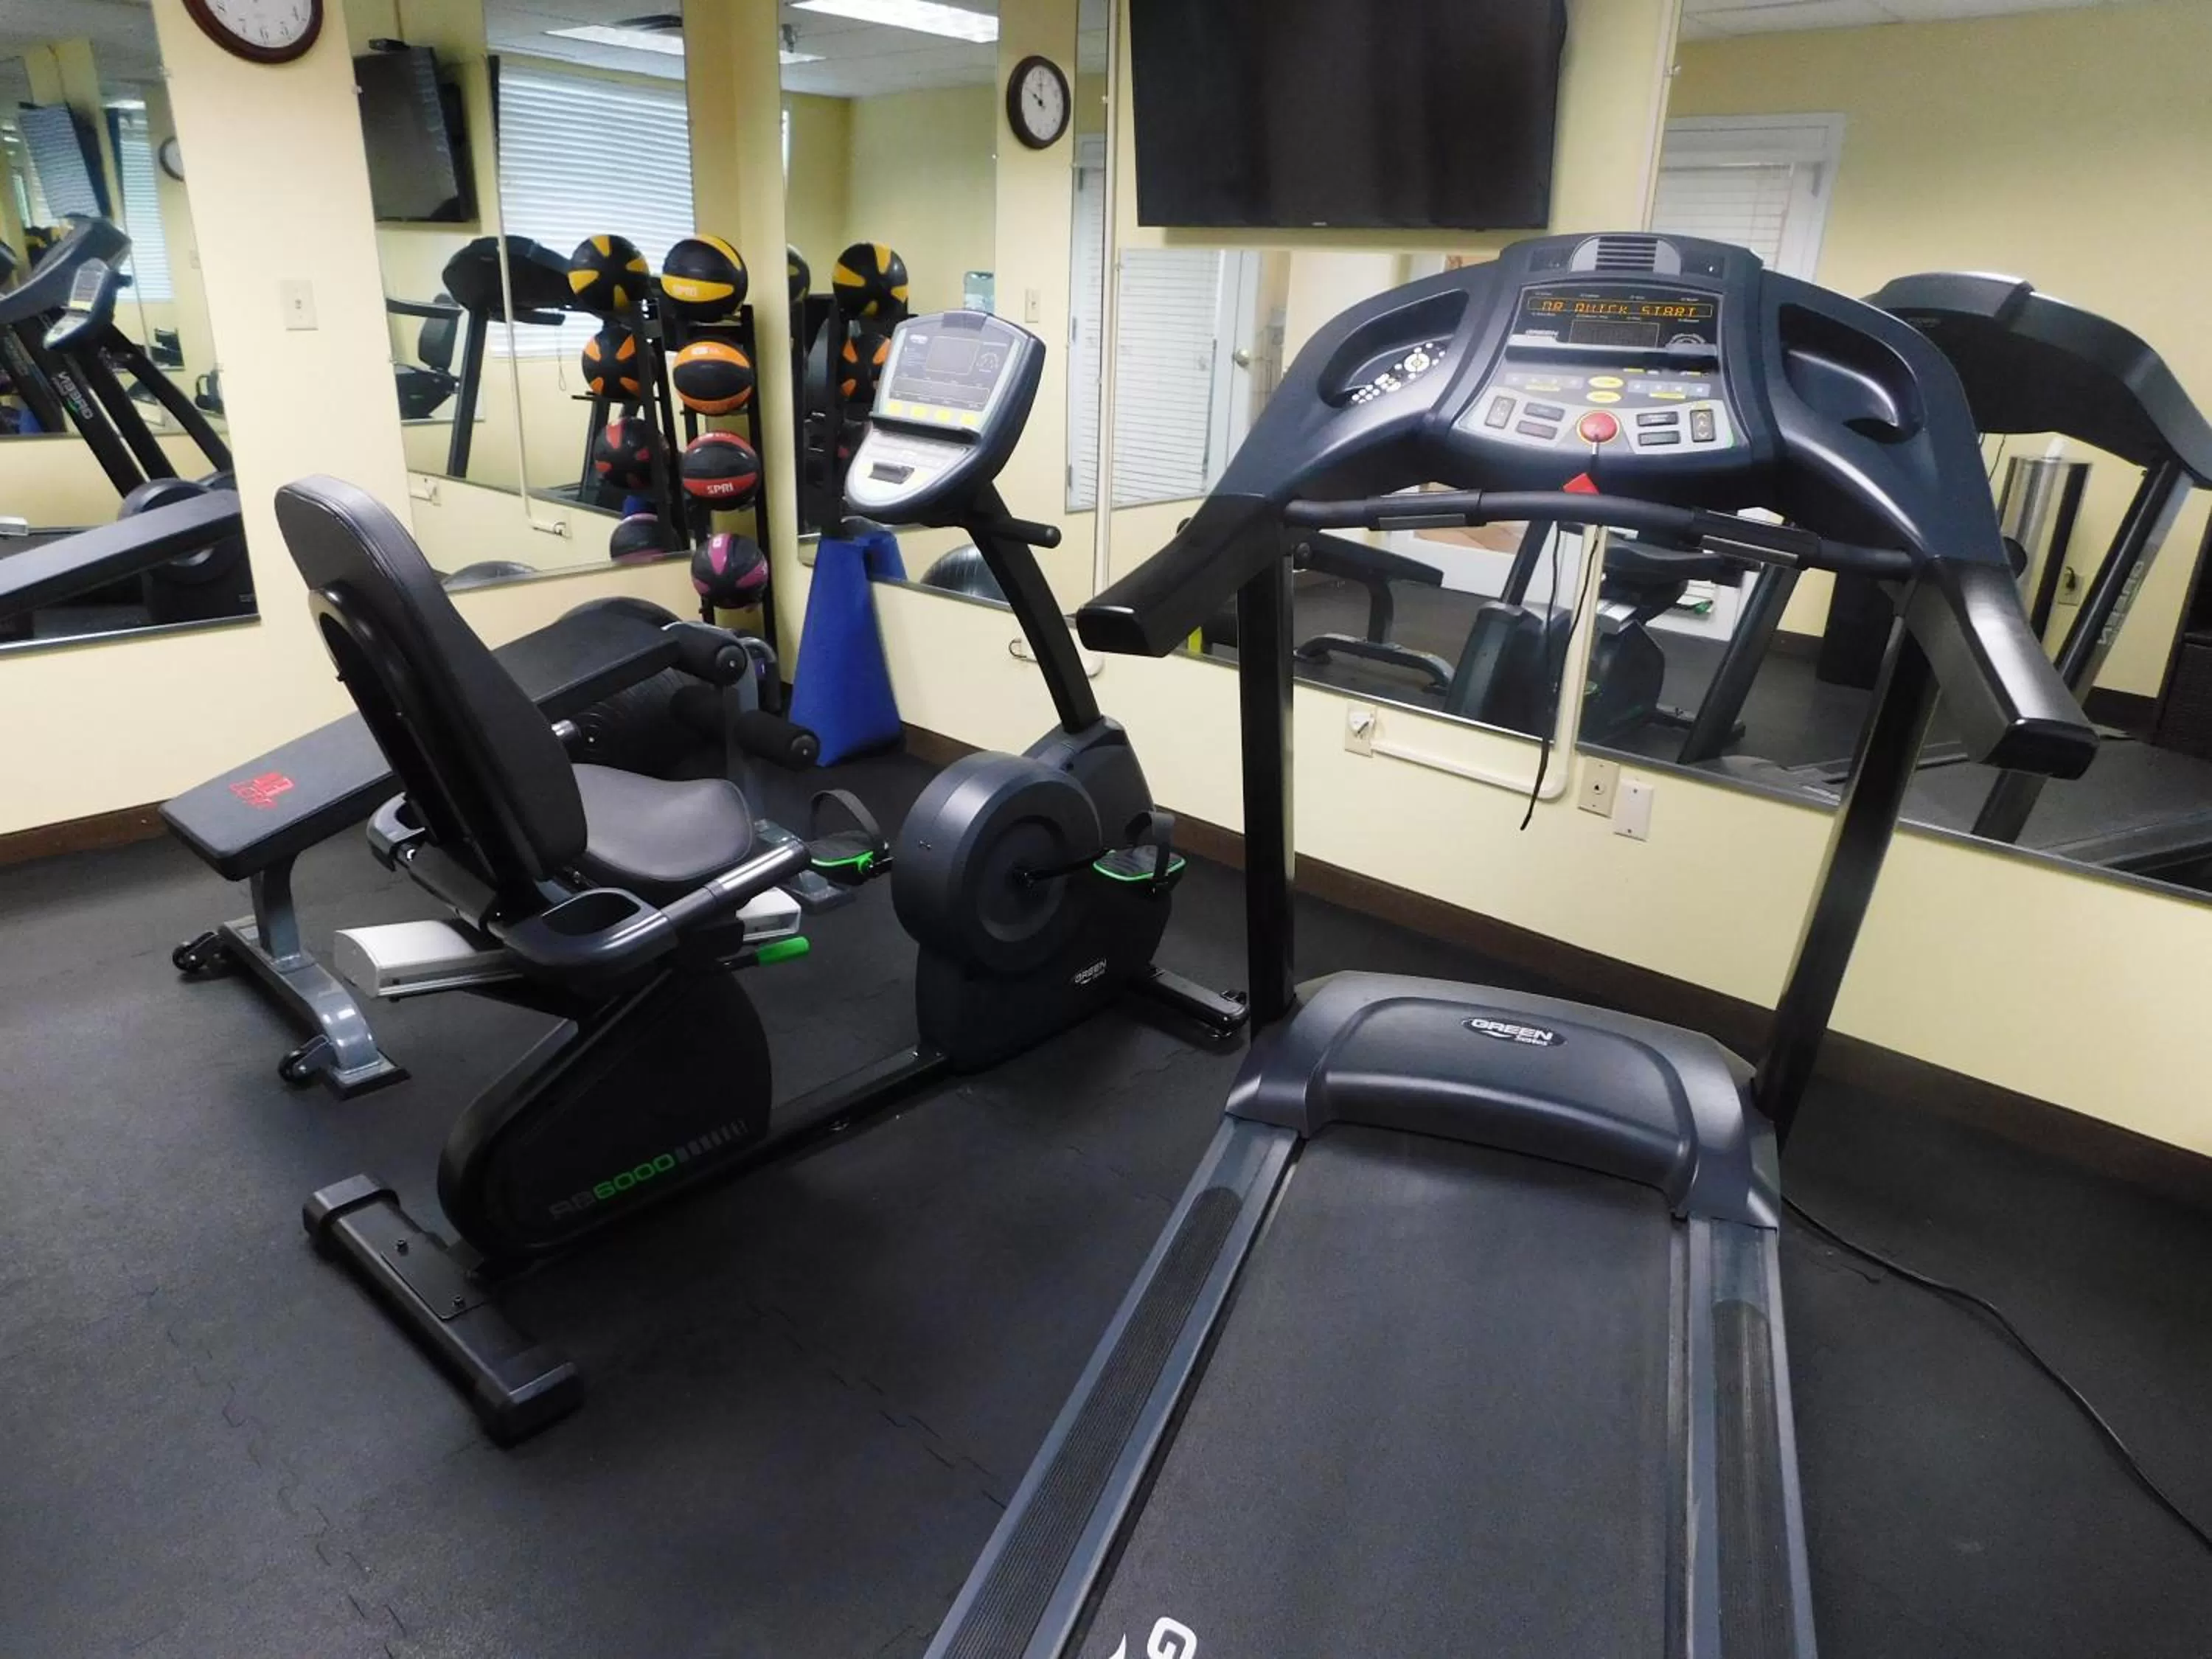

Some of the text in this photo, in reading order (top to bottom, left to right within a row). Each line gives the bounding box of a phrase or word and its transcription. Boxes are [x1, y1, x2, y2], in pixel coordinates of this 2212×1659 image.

[1574, 302, 1629, 314] QUICK
[1641, 305, 1697, 318] START
[706, 482, 734, 495] SPRI
[1074, 959, 1107, 983] GREEN
[1471, 1018, 1554, 1040] GREEN
